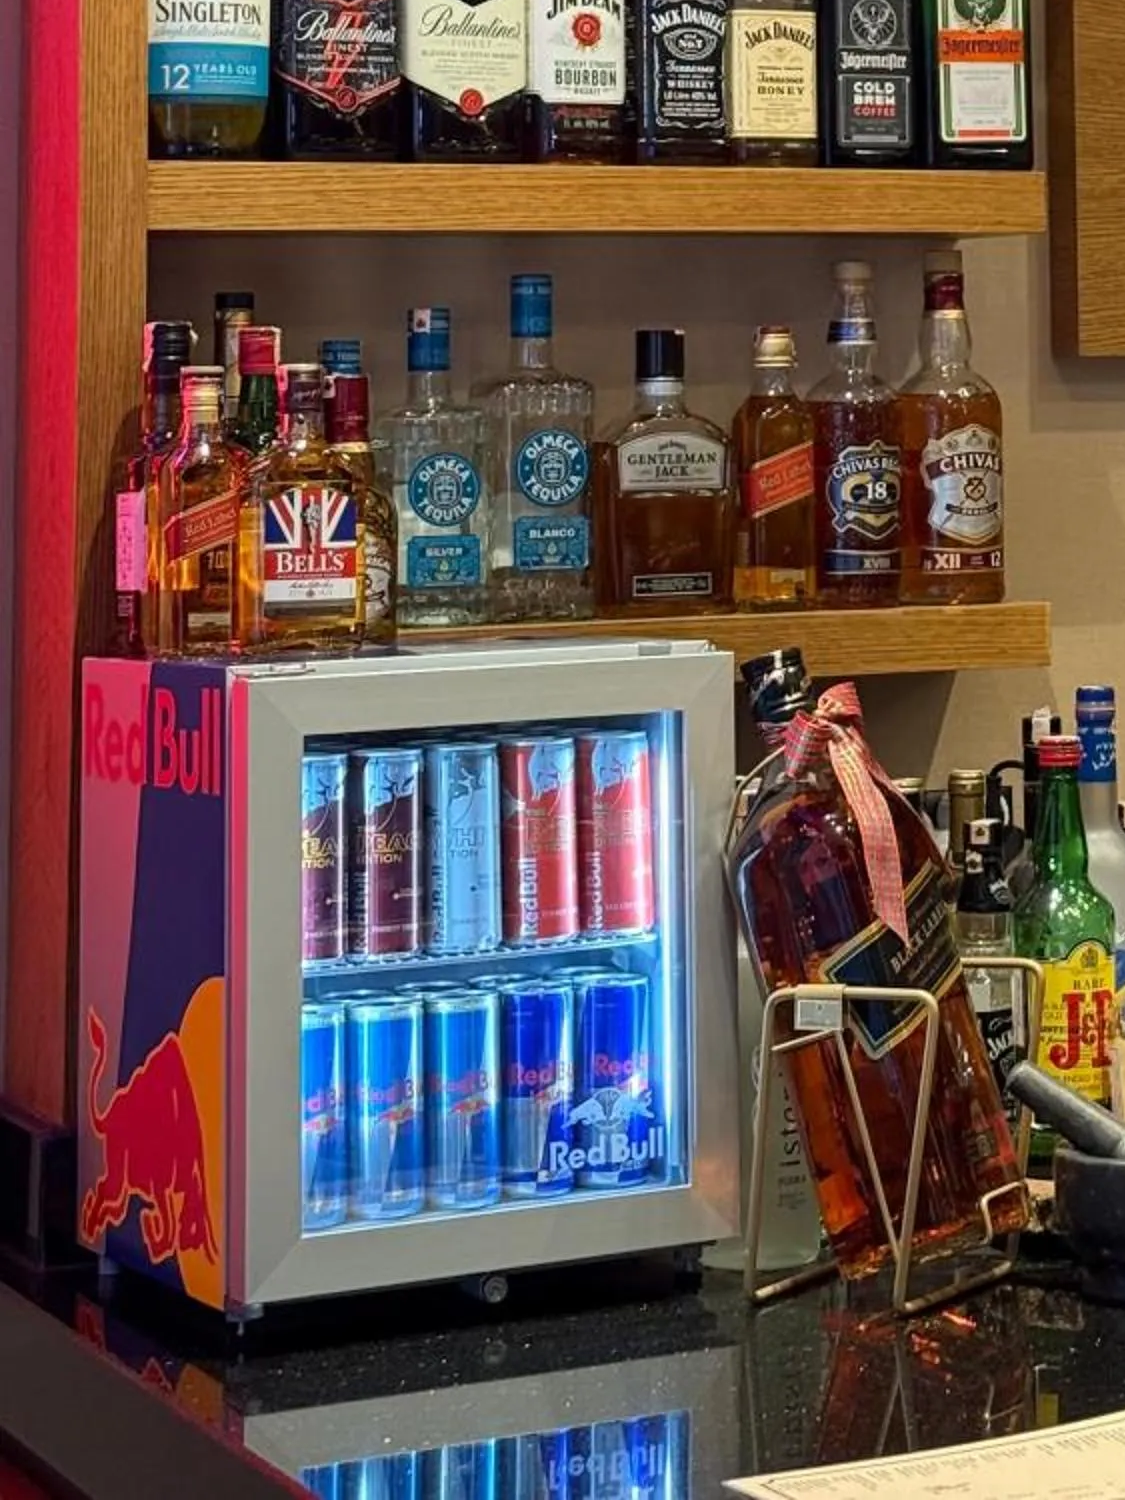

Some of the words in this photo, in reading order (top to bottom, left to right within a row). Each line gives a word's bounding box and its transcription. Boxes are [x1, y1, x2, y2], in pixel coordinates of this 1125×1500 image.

[294, 9, 396, 43] Ballantine's
[651, 7, 681, 34] JACK
[745, 30, 771, 49] JACK
[161, 64, 190, 90] 12
[194, 63, 233, 74] YEARS
[555, 69, 617, 86] BOURBON
[667, 80, 714, 89] WHISKEY
[757, 86, 804, 95] HONEY
[853, 81, 895, 93] COLD
[853, 94, 896, 105] BREW
[853, 105, 896, 117] COFFEE
[525, 434, 580, 458] OLMECA
[627, 452, 717, 465] GENTLEMAN
[418, 457, 469, 484] OLMECA
[655, 465, 691, 478] JACK
[832, 458, 879, 479] CHIVAS
[526, 474, 582, 501] TEQUILA
[865, 481, 887, 499] 18
[417, 497, 469, 524] TEQUILA
[529, 528, 575, 540] BLANCO
[277, 550, 345, 573] BELL'S
[934, 553, 961, 569] XII
[84, 681, 148, 786] Red
[154, 686, 221, 797] Bull
[509, 1058, 555, 1085] Red
[550, 1131, 609, 1173] Red
[611, 1125, 664, 1165] Bull
